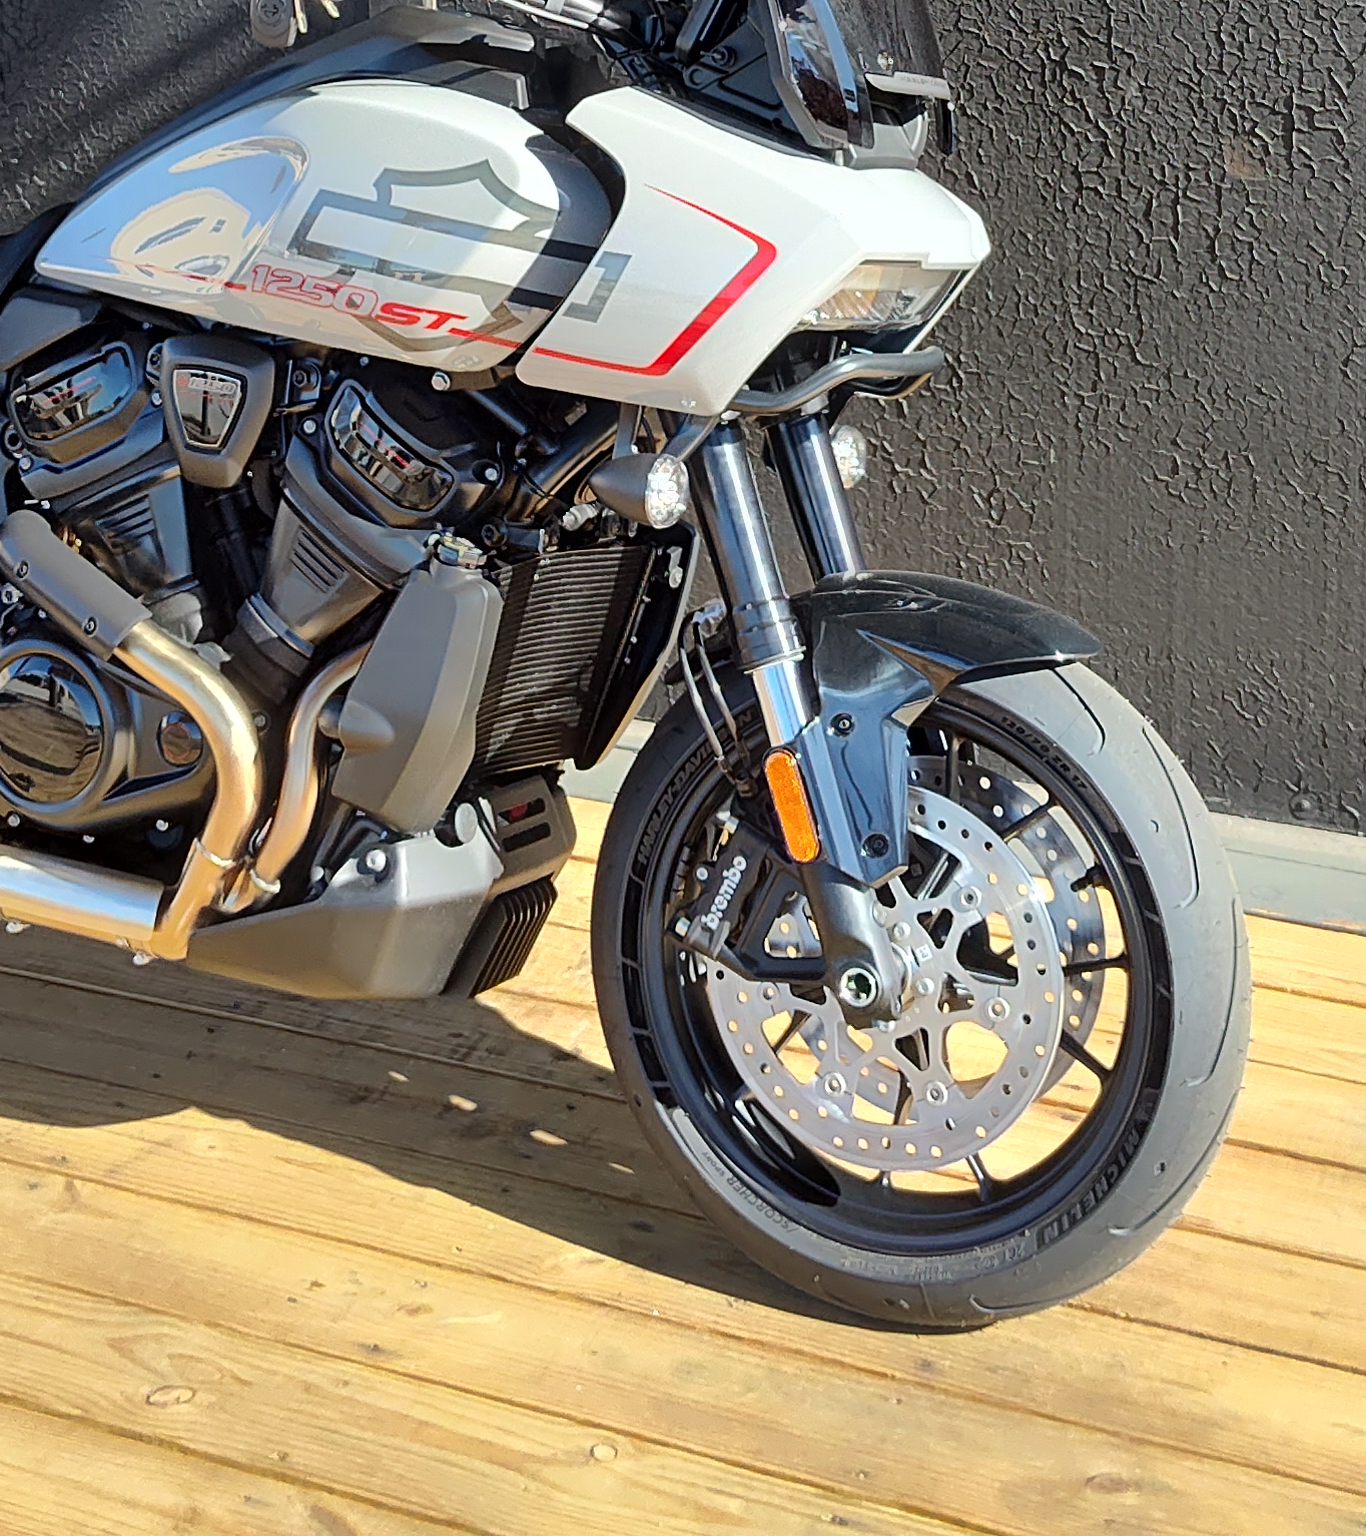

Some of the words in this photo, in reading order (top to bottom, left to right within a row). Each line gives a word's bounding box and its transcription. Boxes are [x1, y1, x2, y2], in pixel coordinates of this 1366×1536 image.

[1000, 715, 1050, 754] 120/70
[700, 855, 747, 930] brembo
[1042, 1127, 1143, 1245] MICHELIN
